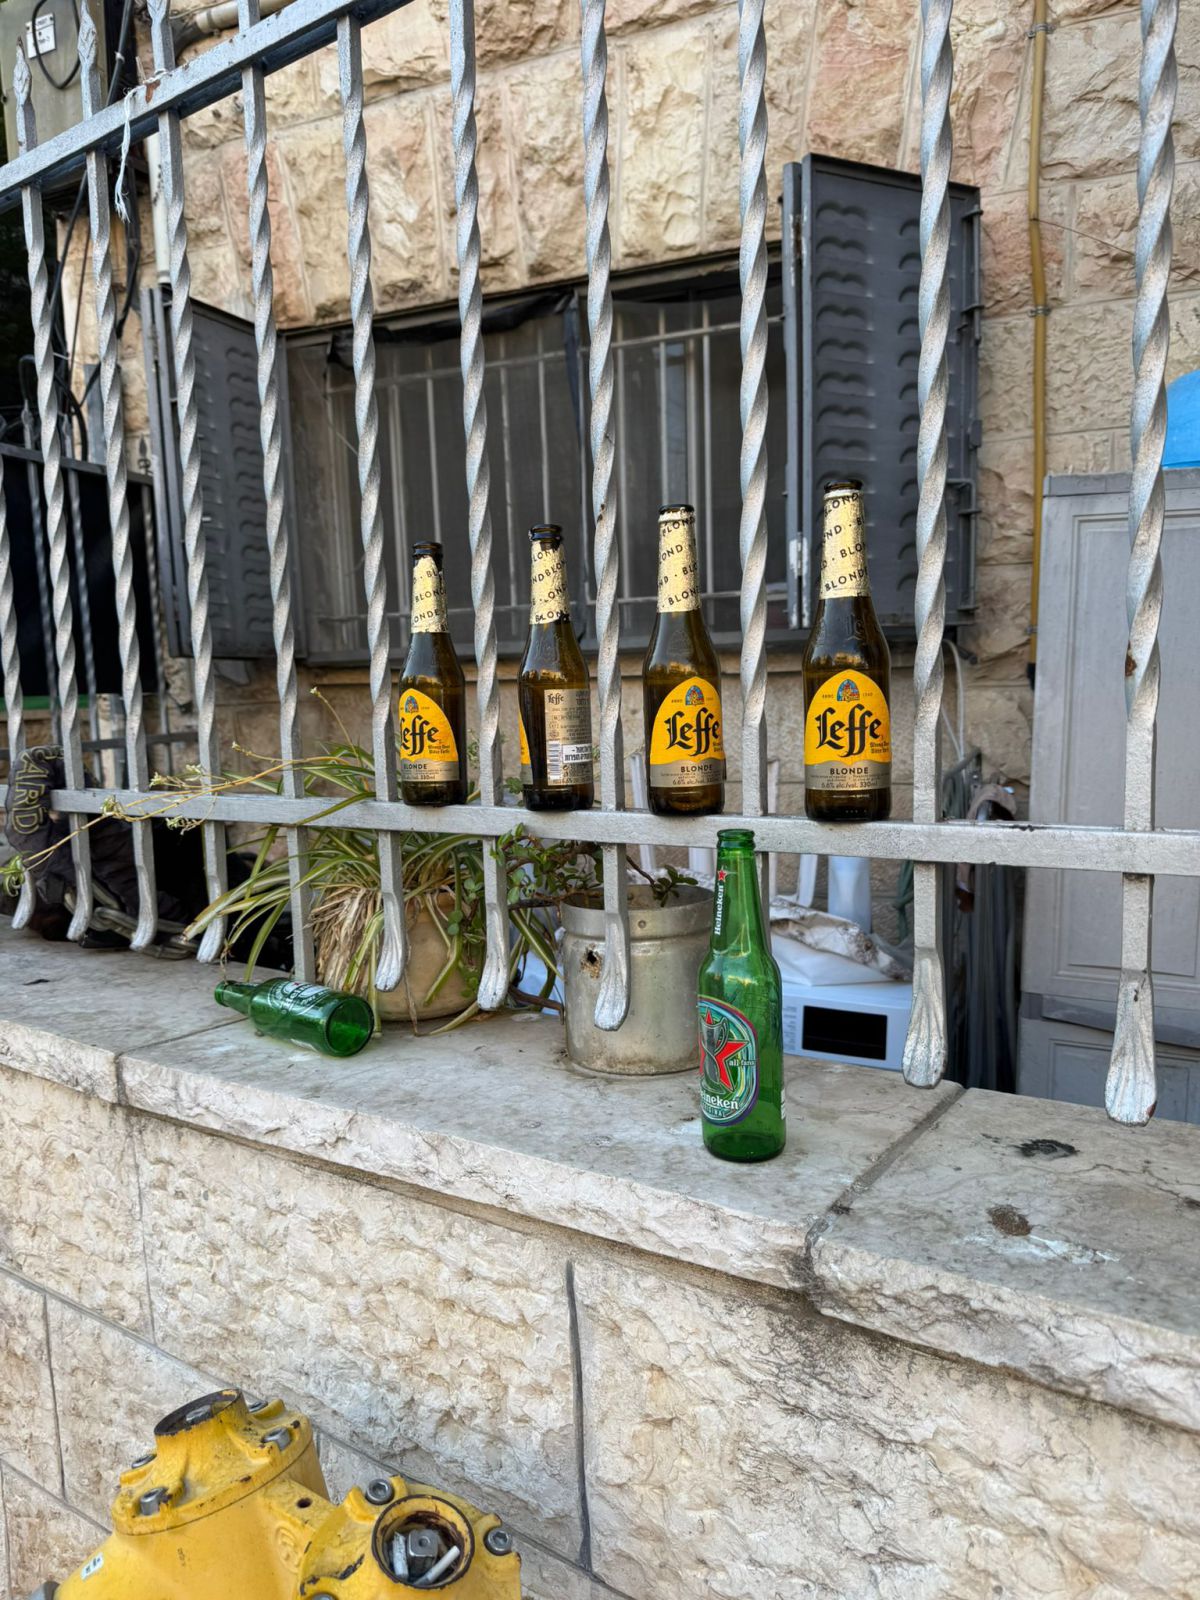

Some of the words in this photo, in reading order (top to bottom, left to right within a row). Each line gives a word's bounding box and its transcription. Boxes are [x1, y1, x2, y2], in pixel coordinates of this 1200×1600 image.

[664, 707, 720, 757] Leffe
[815, 703, 882, 758] Leffe
[680, 764, 713, 773] BLONDE
[829, 766, 869, 775] BLONDE
[714, 884, 724, 936] Heineken
[700, 1089, 739, 1110] eineken
